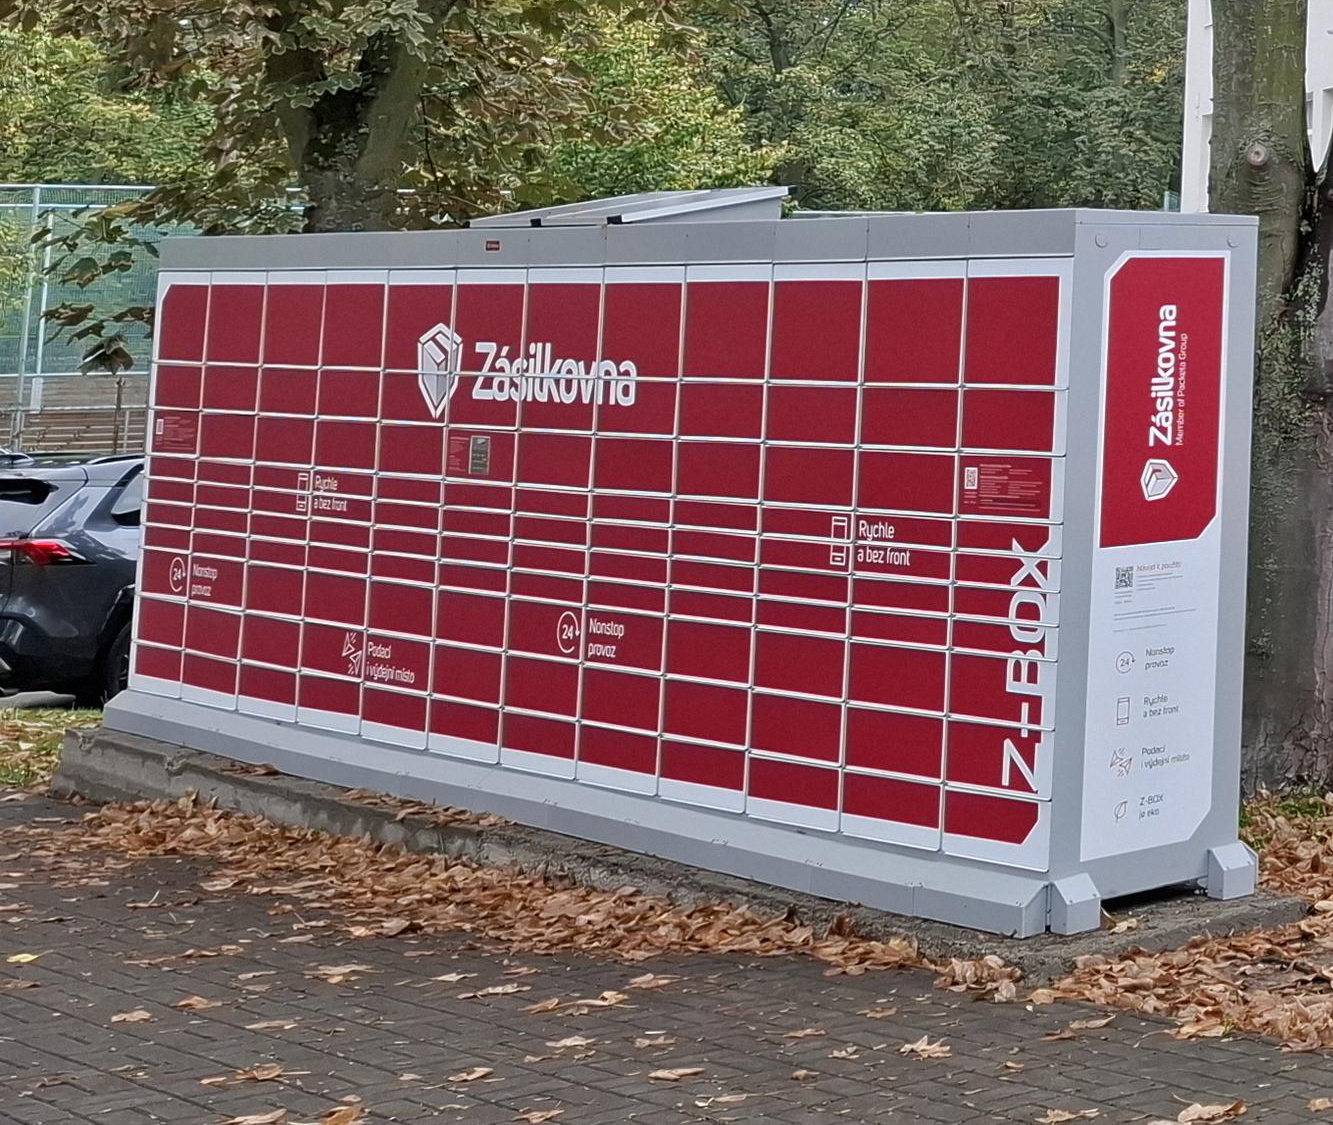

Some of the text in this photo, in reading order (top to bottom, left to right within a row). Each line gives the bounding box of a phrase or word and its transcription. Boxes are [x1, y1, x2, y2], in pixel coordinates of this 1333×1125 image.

[471, 341, 638, 407] Zásilkovna
[1148, 304, 1177, 447] Zásilkovna
[1174, 333, 1189, 446] Member of Packeta Group
[315, 475, 338, 493] Rychle
[858, 520, 895, 541] Rychle
[857, 546, 911, 566] a bez front
[173, 568, 182, 581] 24
[192, 563, 218, 581] Nonstop
[561, 623, 574, 640] 24
[588, 618, 625, 639] Nonstop
[367, 641, 392, 659] Podací
[587, 642, 617, 658] provoz
[1001, 536, 1050, 795] Z-BOX
[1119, 658, 1130, 667] 24
[1139, 794, 1164, 806] Z-BOX
